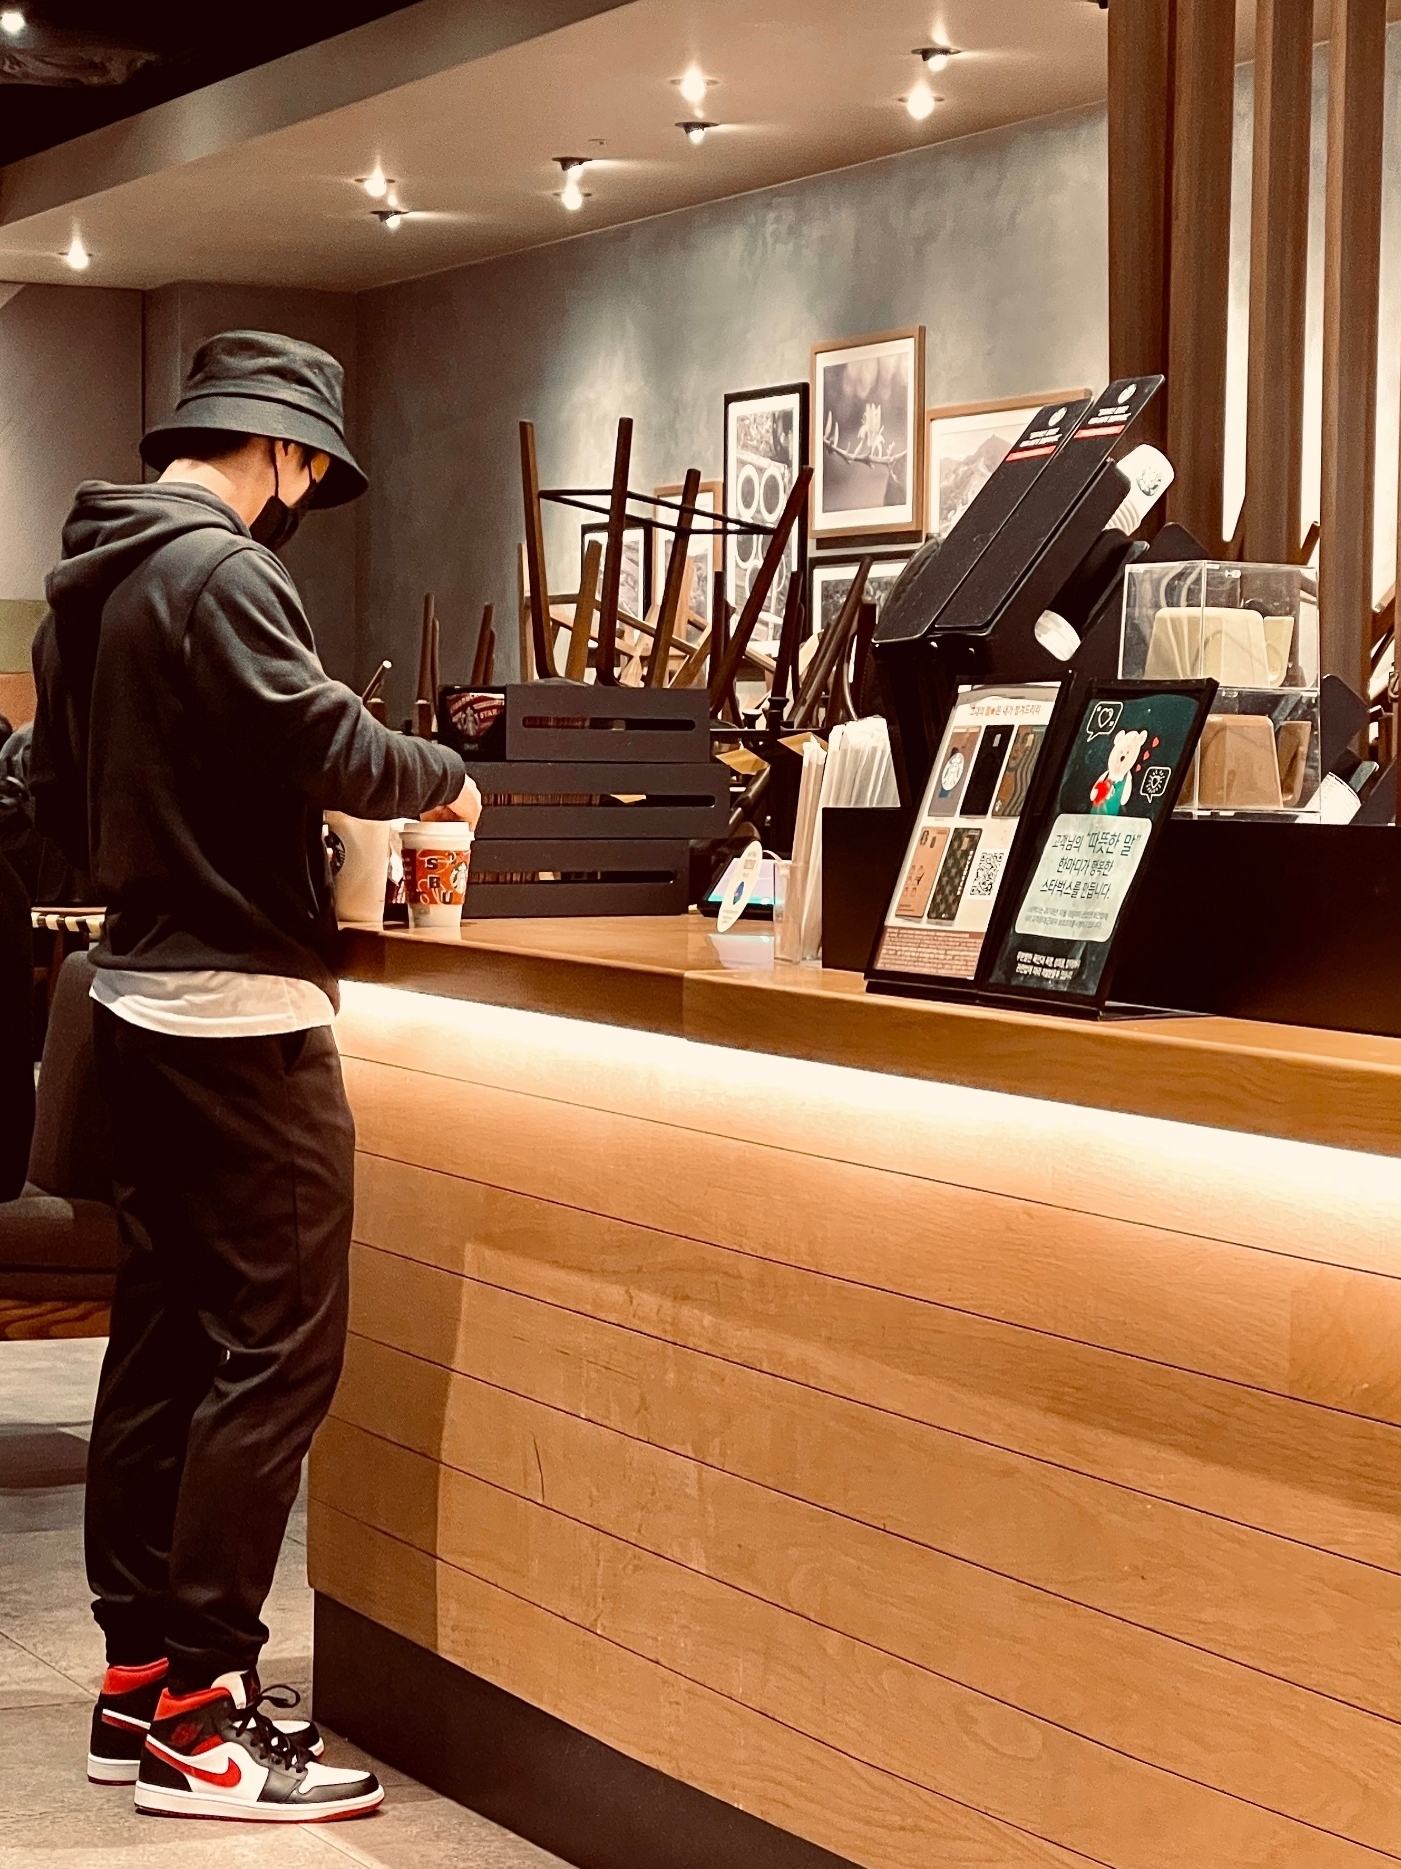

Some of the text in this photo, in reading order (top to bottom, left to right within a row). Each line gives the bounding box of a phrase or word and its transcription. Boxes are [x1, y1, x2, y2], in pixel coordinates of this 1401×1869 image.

[1052, 834, 1084, 853] 고객님의
[1056, 856, 1115, 877] 한마디가 행복한
[1040, 878, 1111, 900] 스타벅스를 만듭니다.
